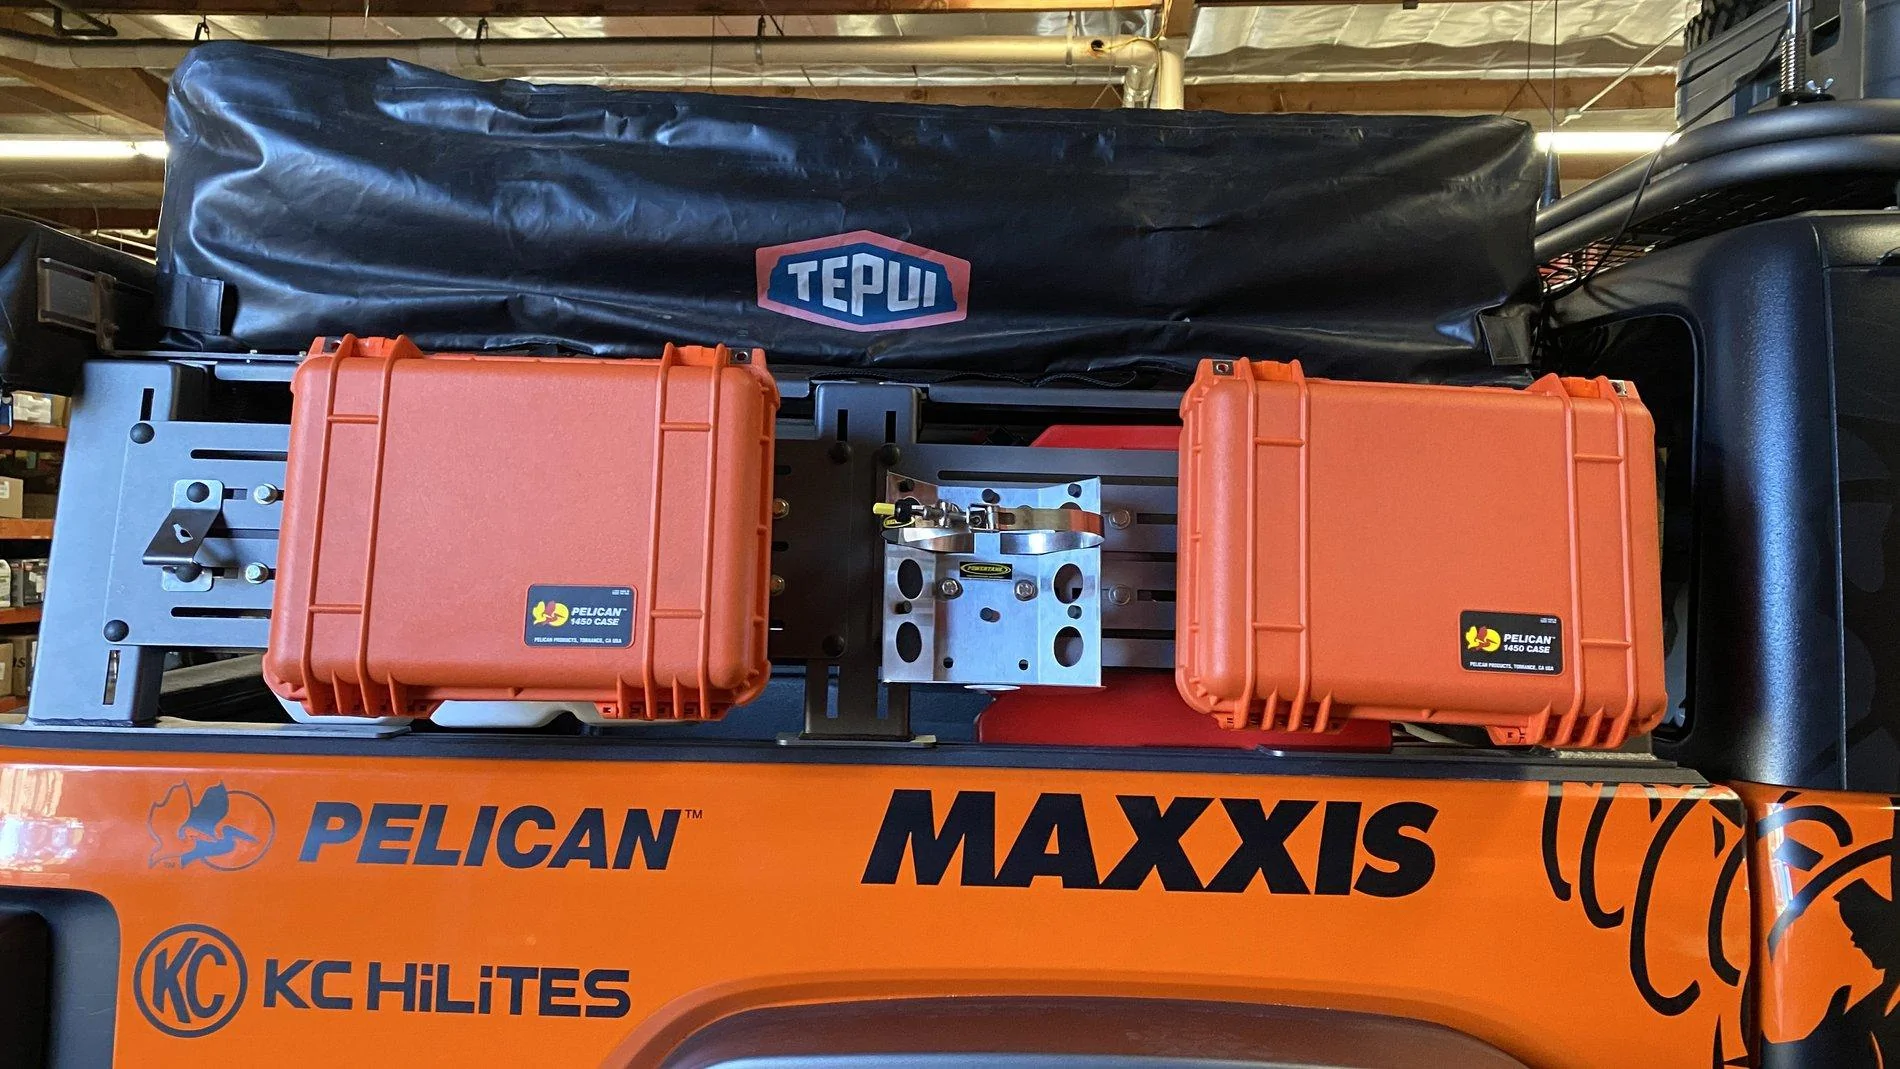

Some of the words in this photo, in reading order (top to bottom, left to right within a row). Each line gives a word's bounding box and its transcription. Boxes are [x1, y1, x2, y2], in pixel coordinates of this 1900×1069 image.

[788, 253, 937, 316] TEPUI
[570, 618, 592, 626] 1450
[594, 618, 620, 626] CASE
[571, 607, 621, 616] PELICAN
[1503, 633, 1552, 645] PELICAN
[1503, 644, 1525, 653] 1450
[1526, 645, 1551, 654] CASE
[300, 802, 682, 871] PELICAN
[860, 788, 1438, 898] MAXXIS
[152, 937, 227, 1024] KC
[263, 958, 353, 1010] KC
